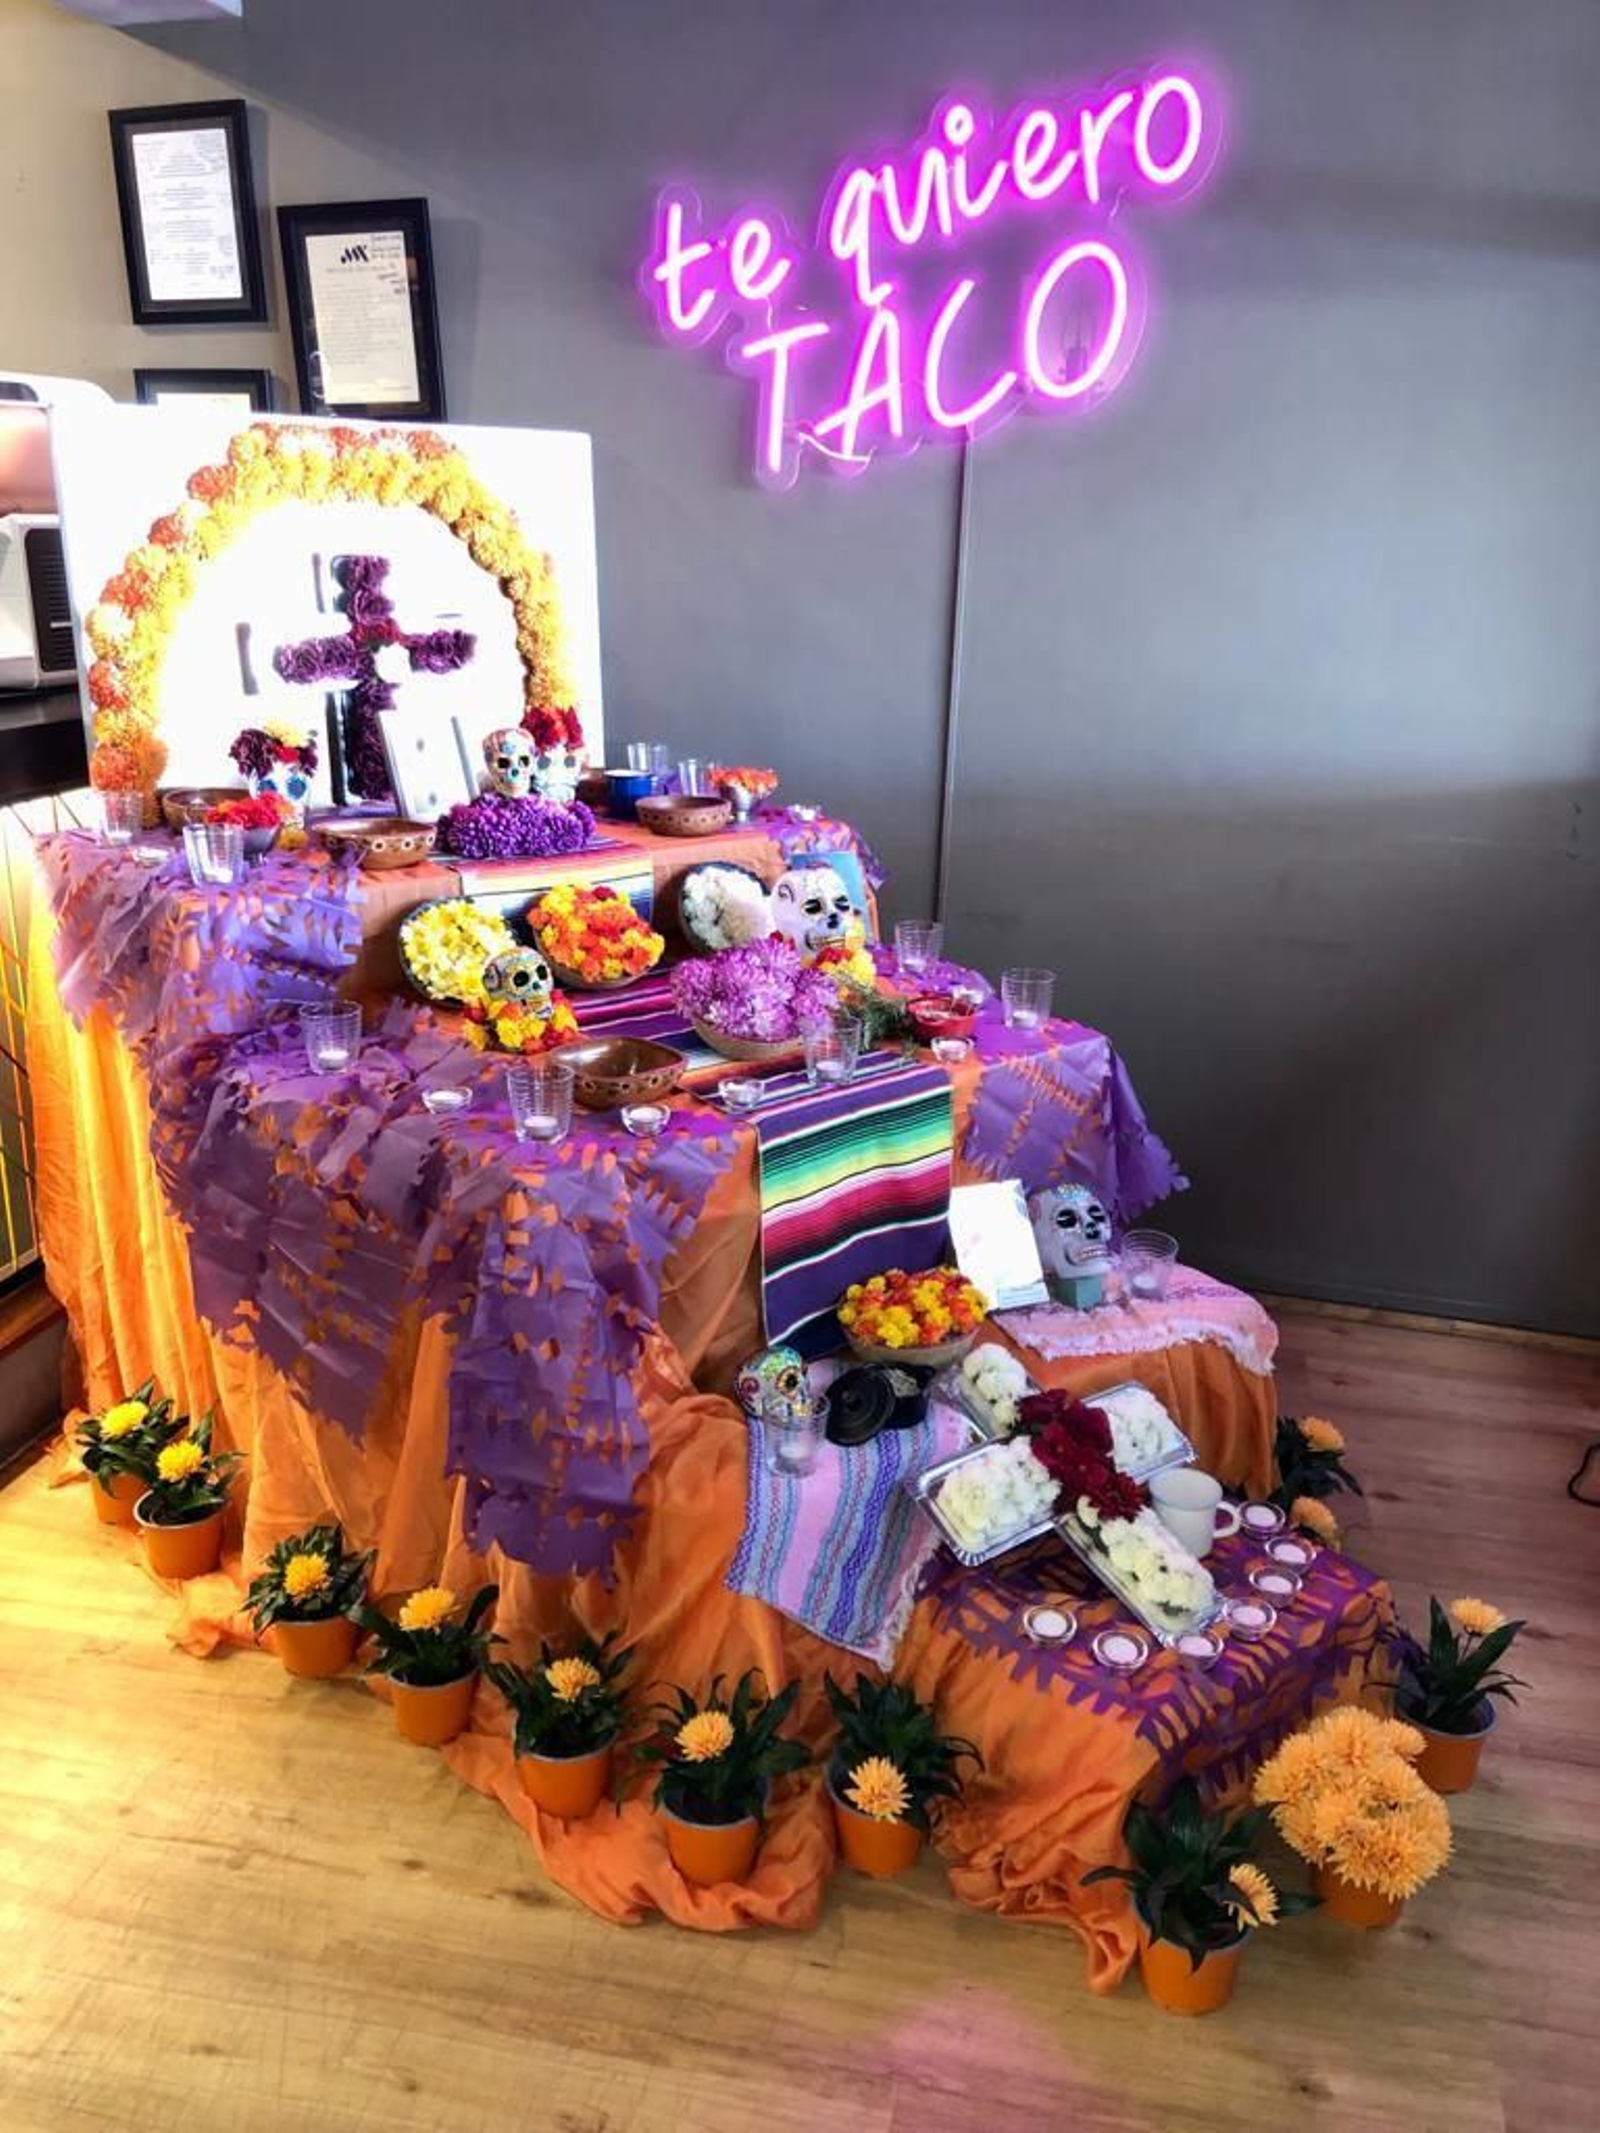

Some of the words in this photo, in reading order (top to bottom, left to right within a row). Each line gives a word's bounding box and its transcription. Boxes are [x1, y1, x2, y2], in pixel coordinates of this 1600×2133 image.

[653, 202, 792, 330] te
[829, 75, 1203, 307] quiero
[741, 240, 1128, 473] TACO
